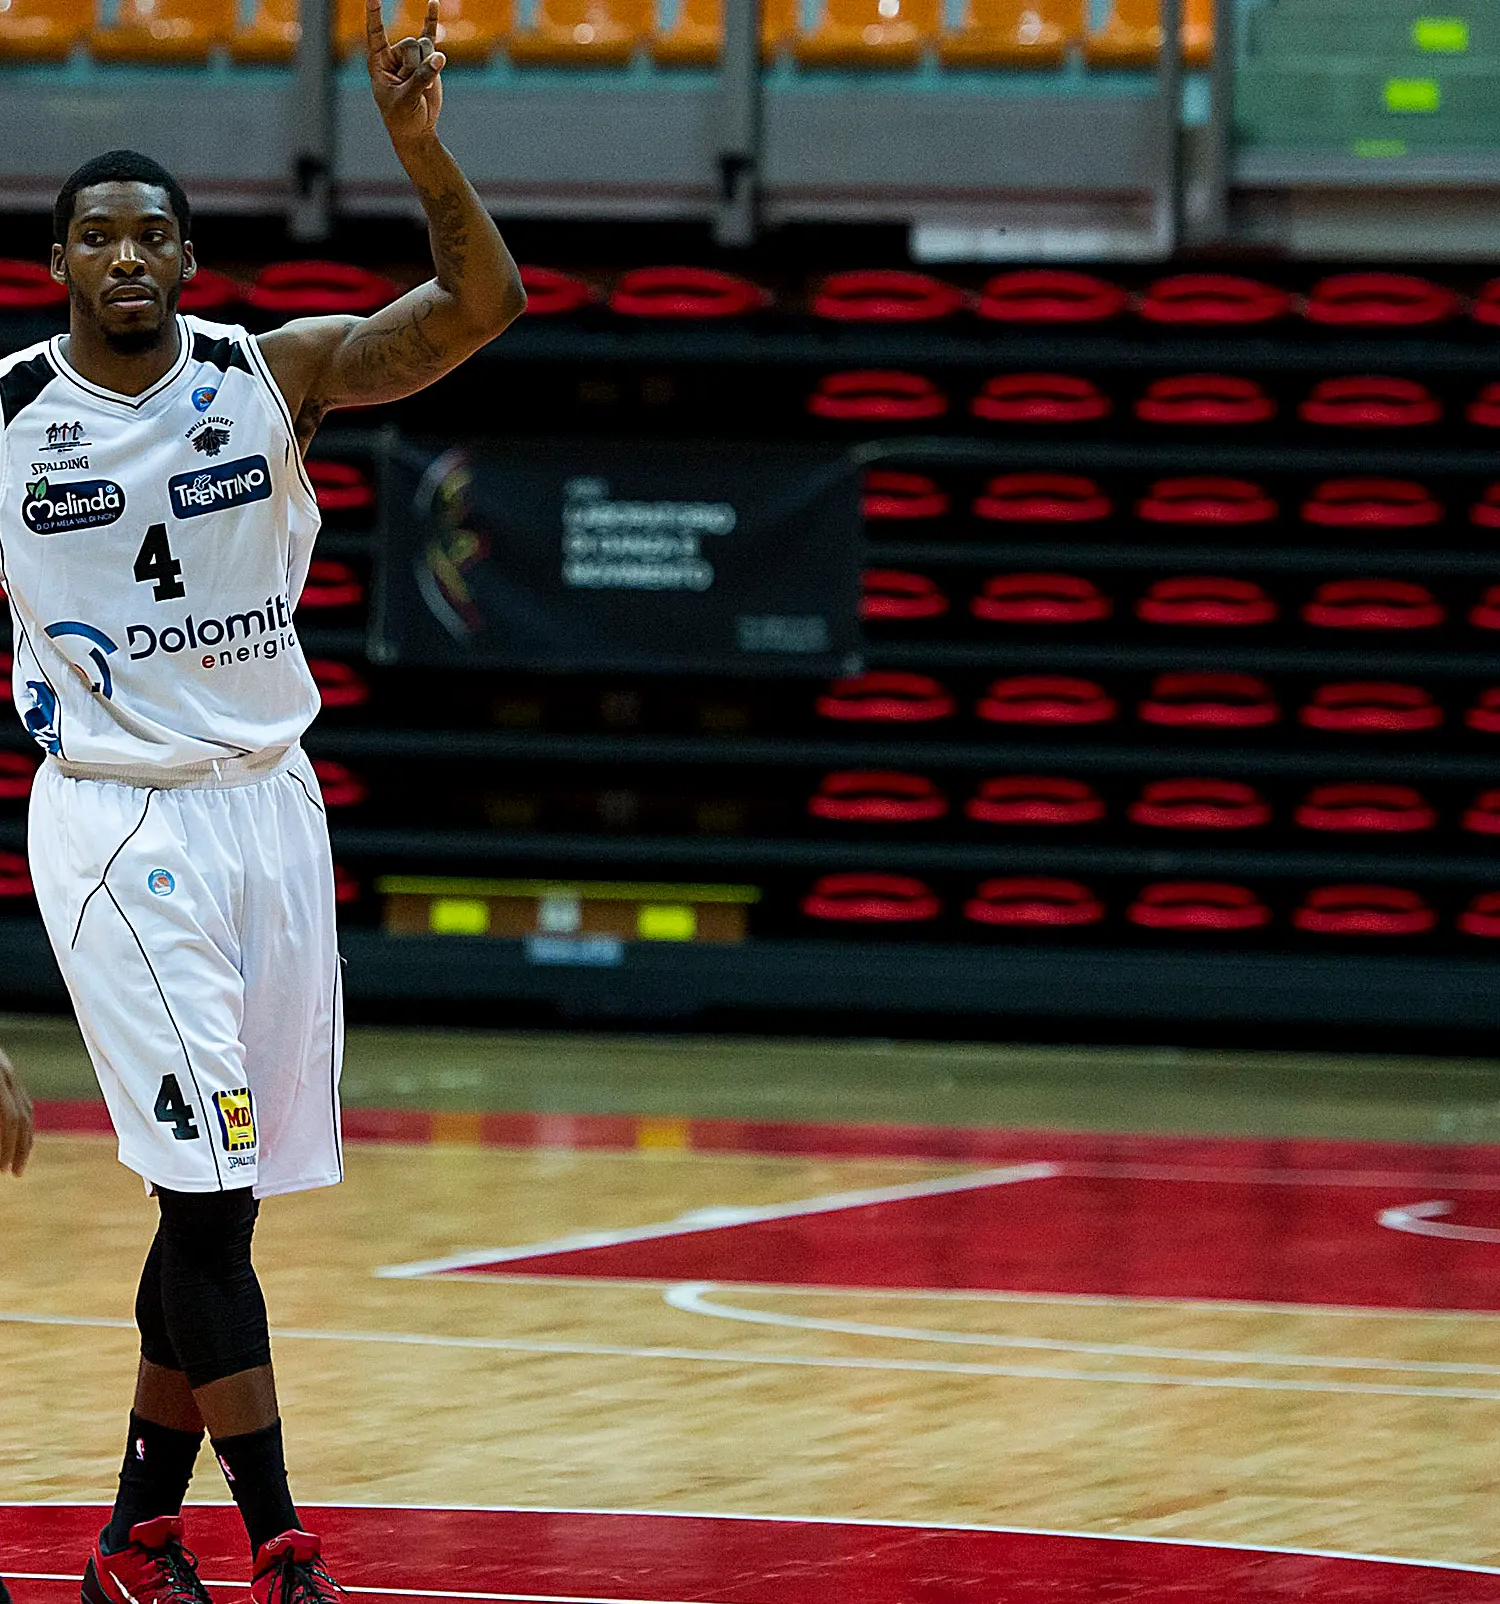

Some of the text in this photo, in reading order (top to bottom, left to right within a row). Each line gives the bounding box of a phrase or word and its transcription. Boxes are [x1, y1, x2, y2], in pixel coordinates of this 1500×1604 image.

[30, 455, 90, 476] SPALDING
[132, 522, 186, 603] 4
[153, 1072, 200, 1141] 4
[223, 1106, 252, 1128] MD
